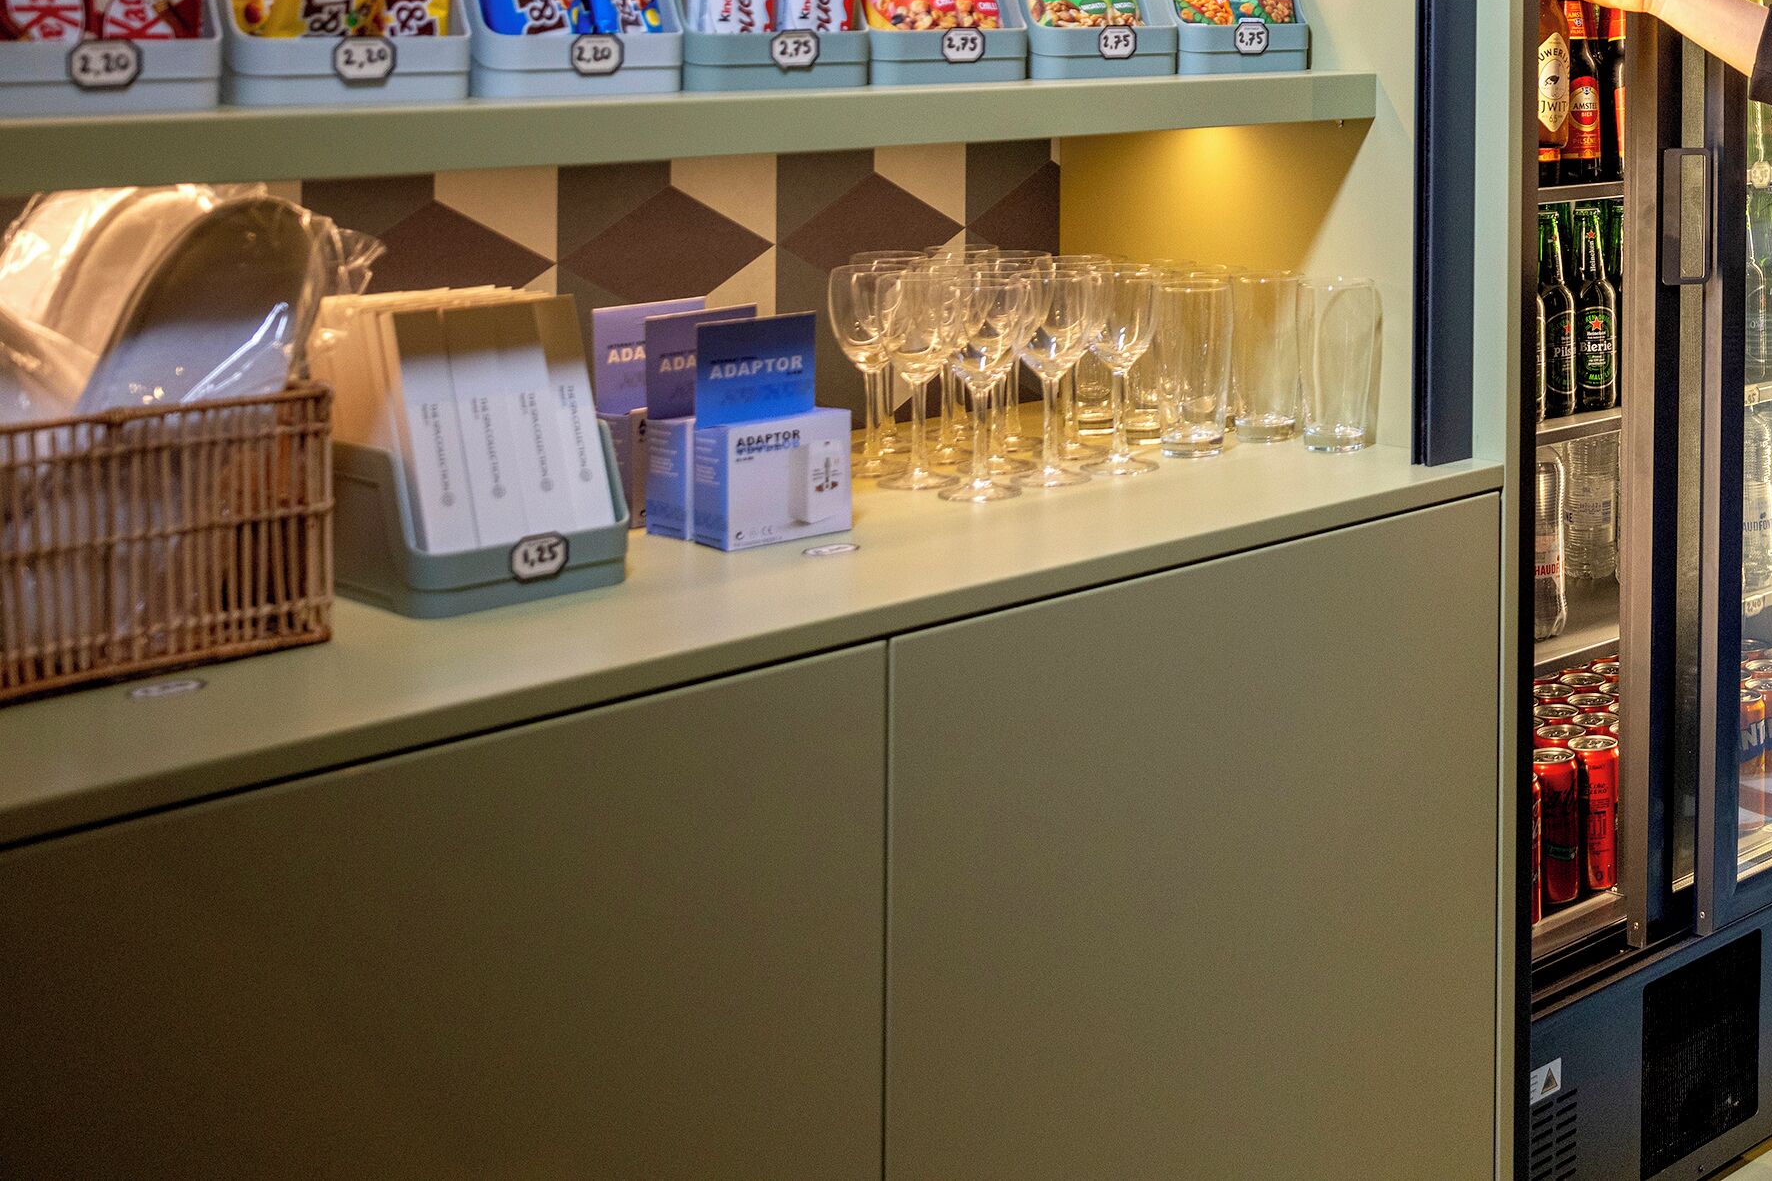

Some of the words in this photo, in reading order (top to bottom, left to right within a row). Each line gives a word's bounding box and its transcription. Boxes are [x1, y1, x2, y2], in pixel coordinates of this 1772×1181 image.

[946, 35, 979, 52] 2,75
[1238, 30, 1266, 47] 2,75
[709, 354, 804, 380] ADAPTOR
[736, 429, 801, 447] ADAPTOR
[522, 541, 564, 568] 1,25
